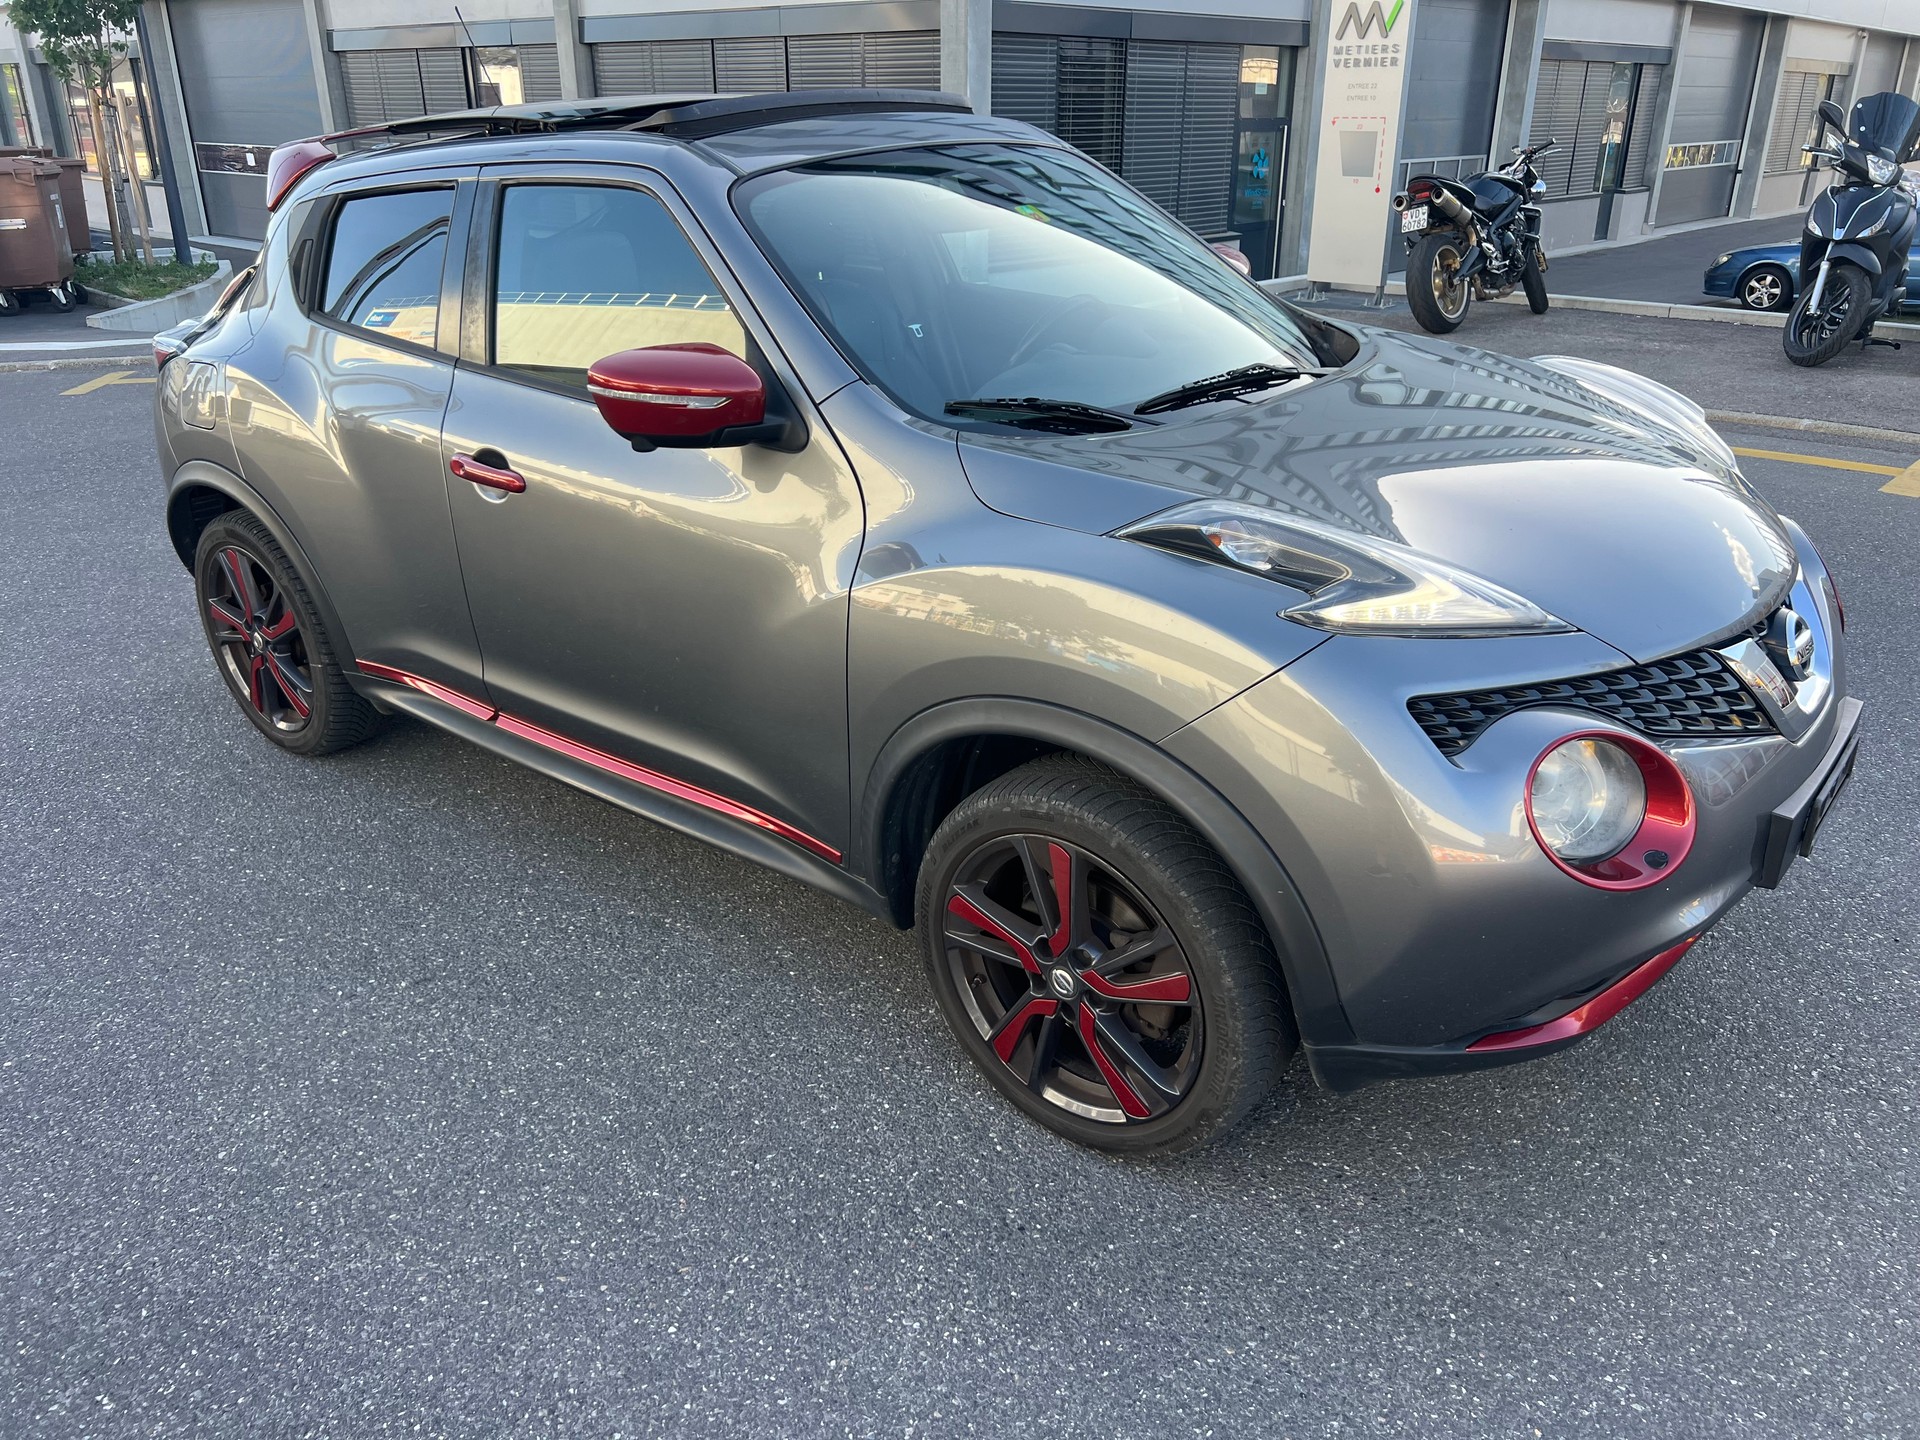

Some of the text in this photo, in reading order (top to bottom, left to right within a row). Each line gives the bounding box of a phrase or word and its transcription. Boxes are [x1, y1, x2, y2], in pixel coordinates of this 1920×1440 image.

[1333, 43, 1400, 56] METIERS
[1333, 56, 1399, 69] VERNIER
[1347, 82, 1370, 90] ENTREE
[1346, 94, 1369, 102] ENTREE
[1409, 209, 1420, 220] VD
[1402, 217, 1426, 232] 60782
